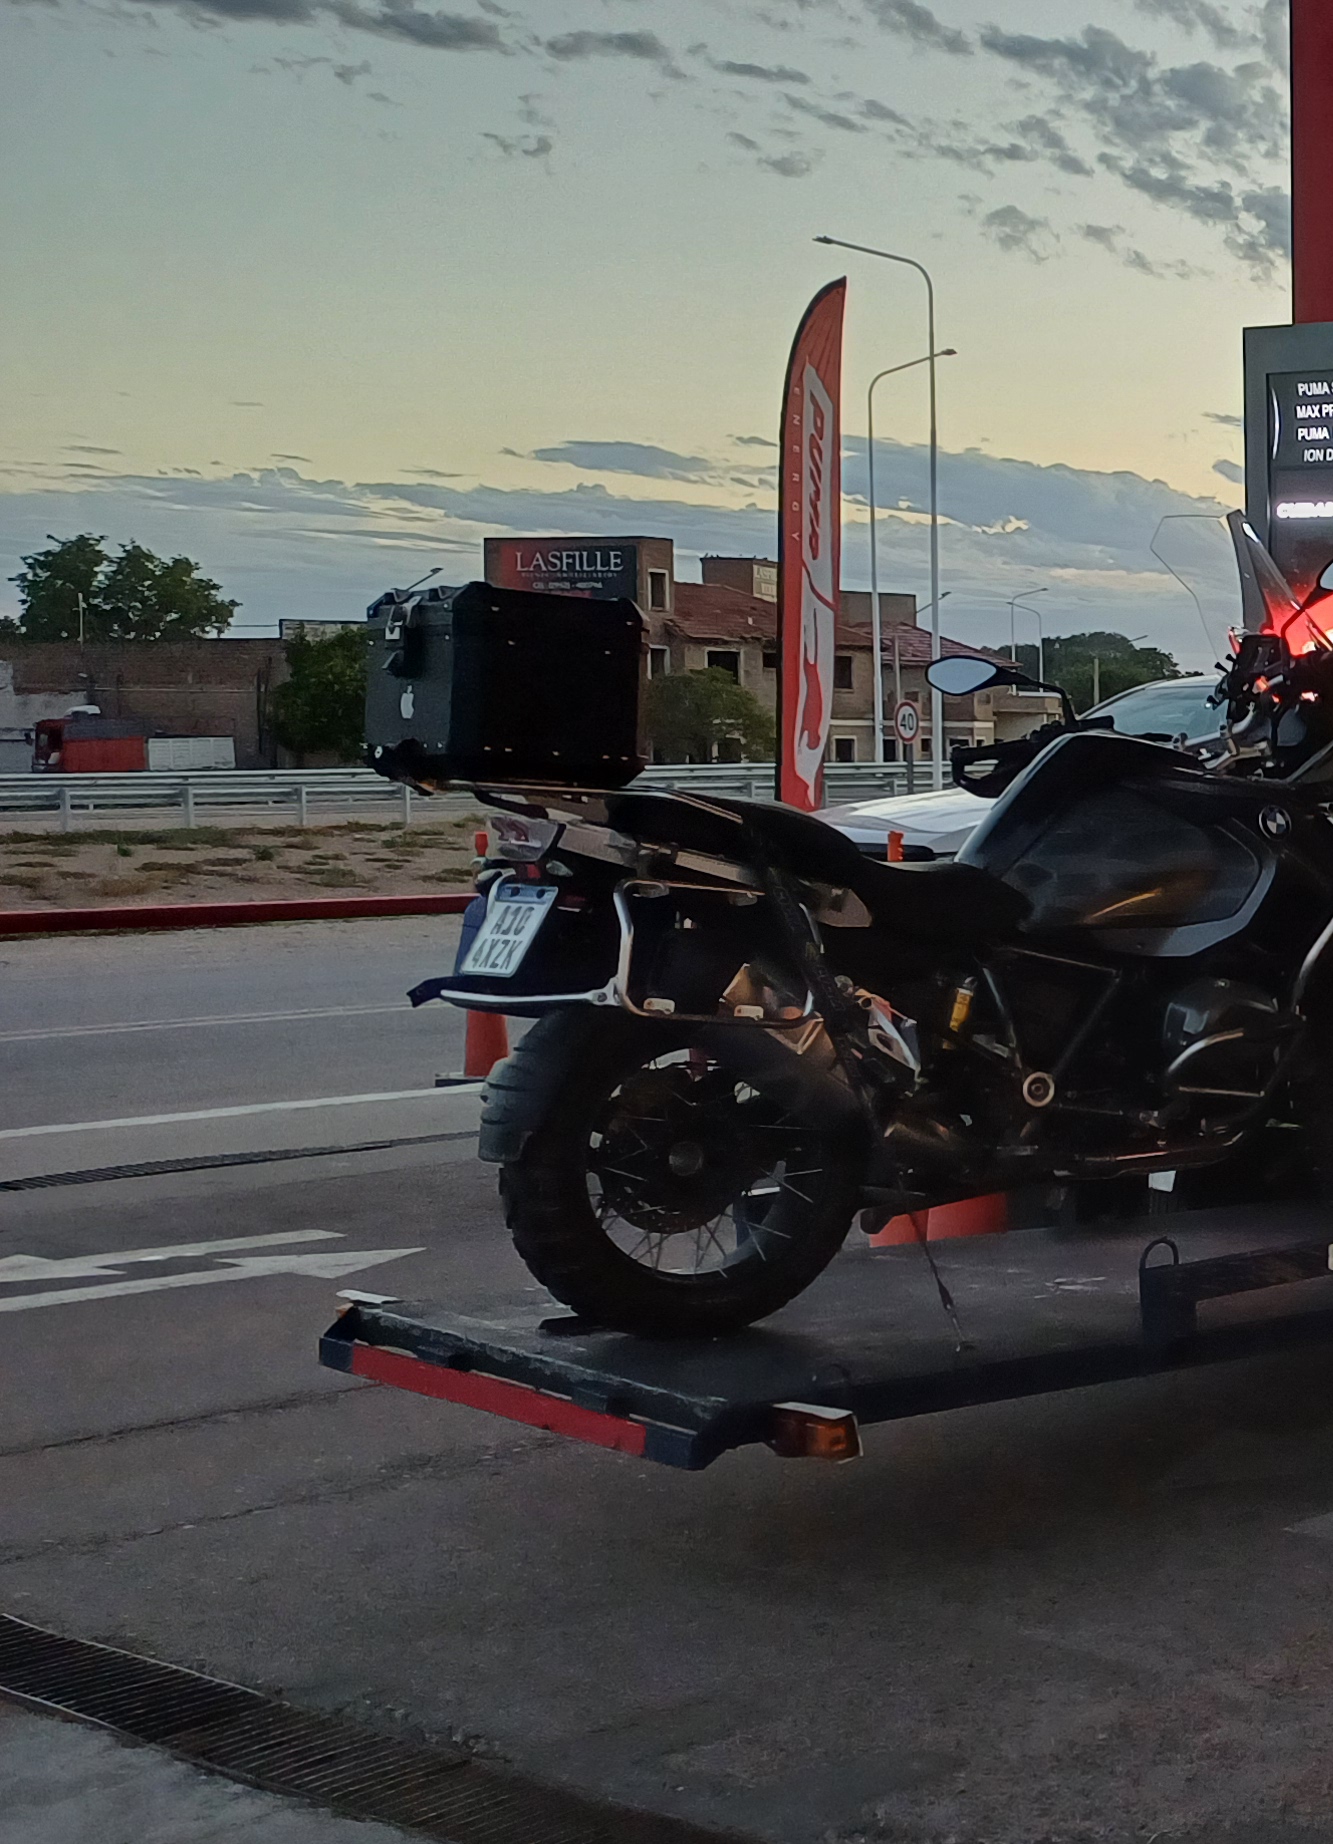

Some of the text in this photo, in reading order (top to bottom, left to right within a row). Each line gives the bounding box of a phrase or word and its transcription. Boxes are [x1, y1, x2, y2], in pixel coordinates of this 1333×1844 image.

[1297, 382, 1330, 396] PUMA
[1296, 404, 1321, 419] MAX
[1297, 426, 1330, 441] PUMA
[1303, 448, 1324, 462] ION
[809, 389, 825, 561] PUMA
[516, 551, 624, 572] LASFILLE
[900, 713, 915, 732] 40
